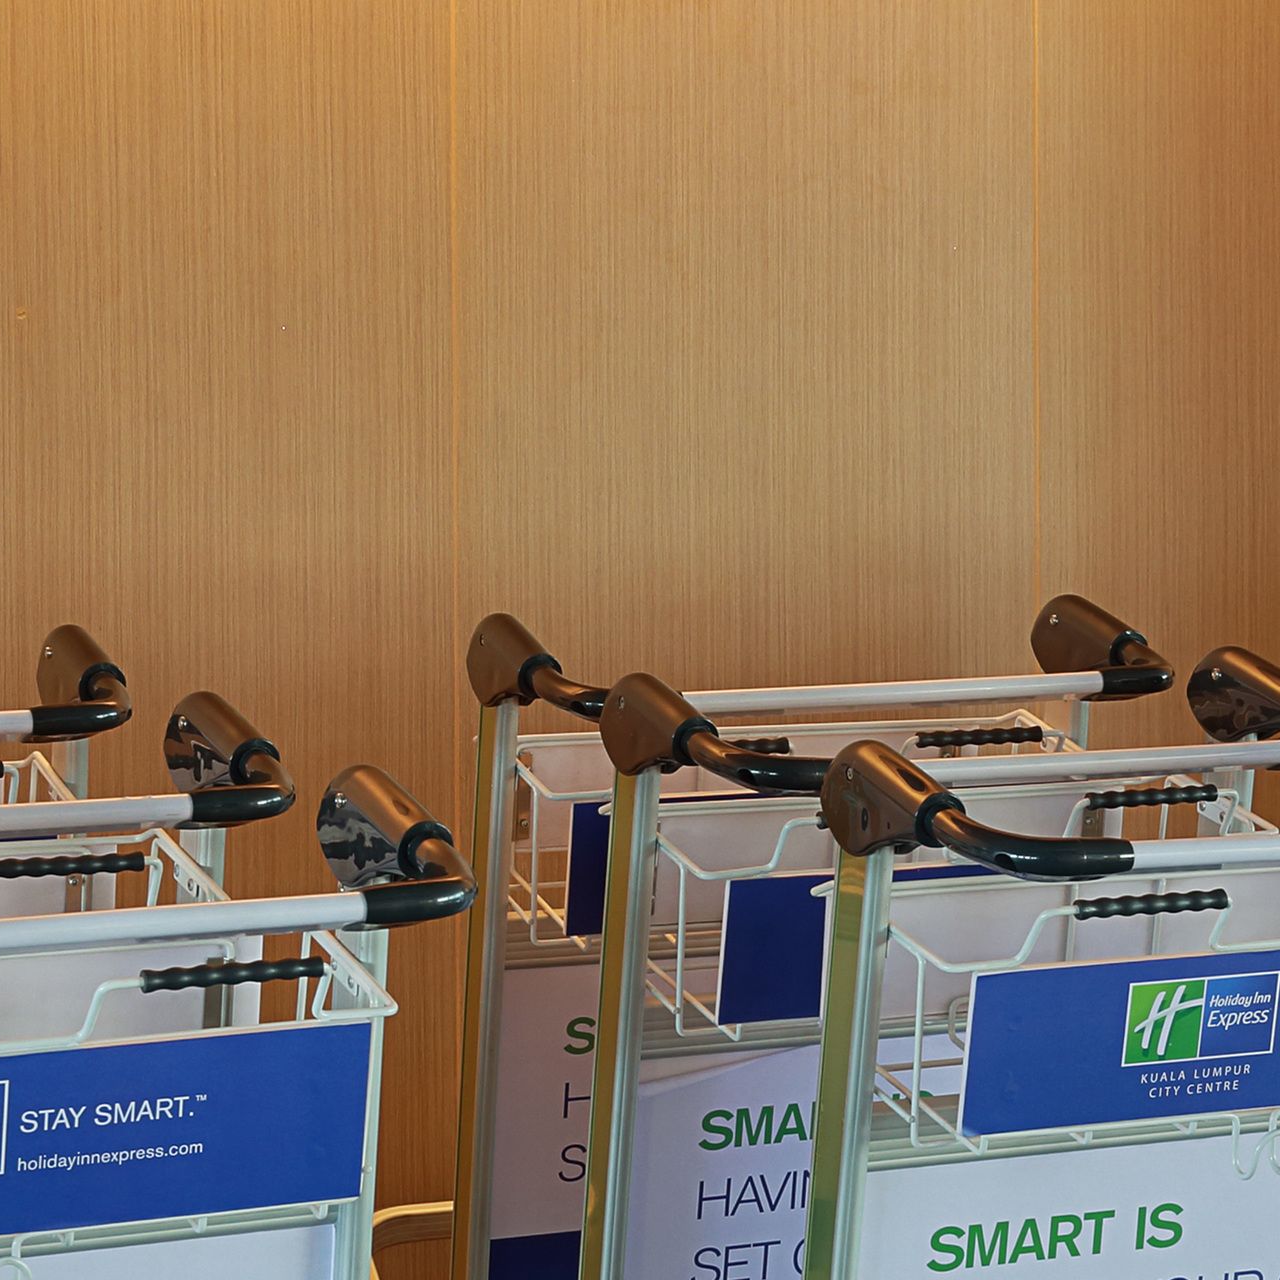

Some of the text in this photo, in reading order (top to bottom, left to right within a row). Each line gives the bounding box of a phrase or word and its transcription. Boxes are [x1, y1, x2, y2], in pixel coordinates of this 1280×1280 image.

[1209, 992, 1271, 1007] Holiday Inn
[1207, 1010, 1269, 1030] Express
[1141, 1064, 1250, 1084] KUALA LUMPUR
[1149, 1080, 1239, 1098] CITY CENTRE
[20, 1106, 86, 1133] STAY
[17, 1143, 203, 1171] holidayinnexpress.com
[927, 1203, 1184, 1272] SMART IS
